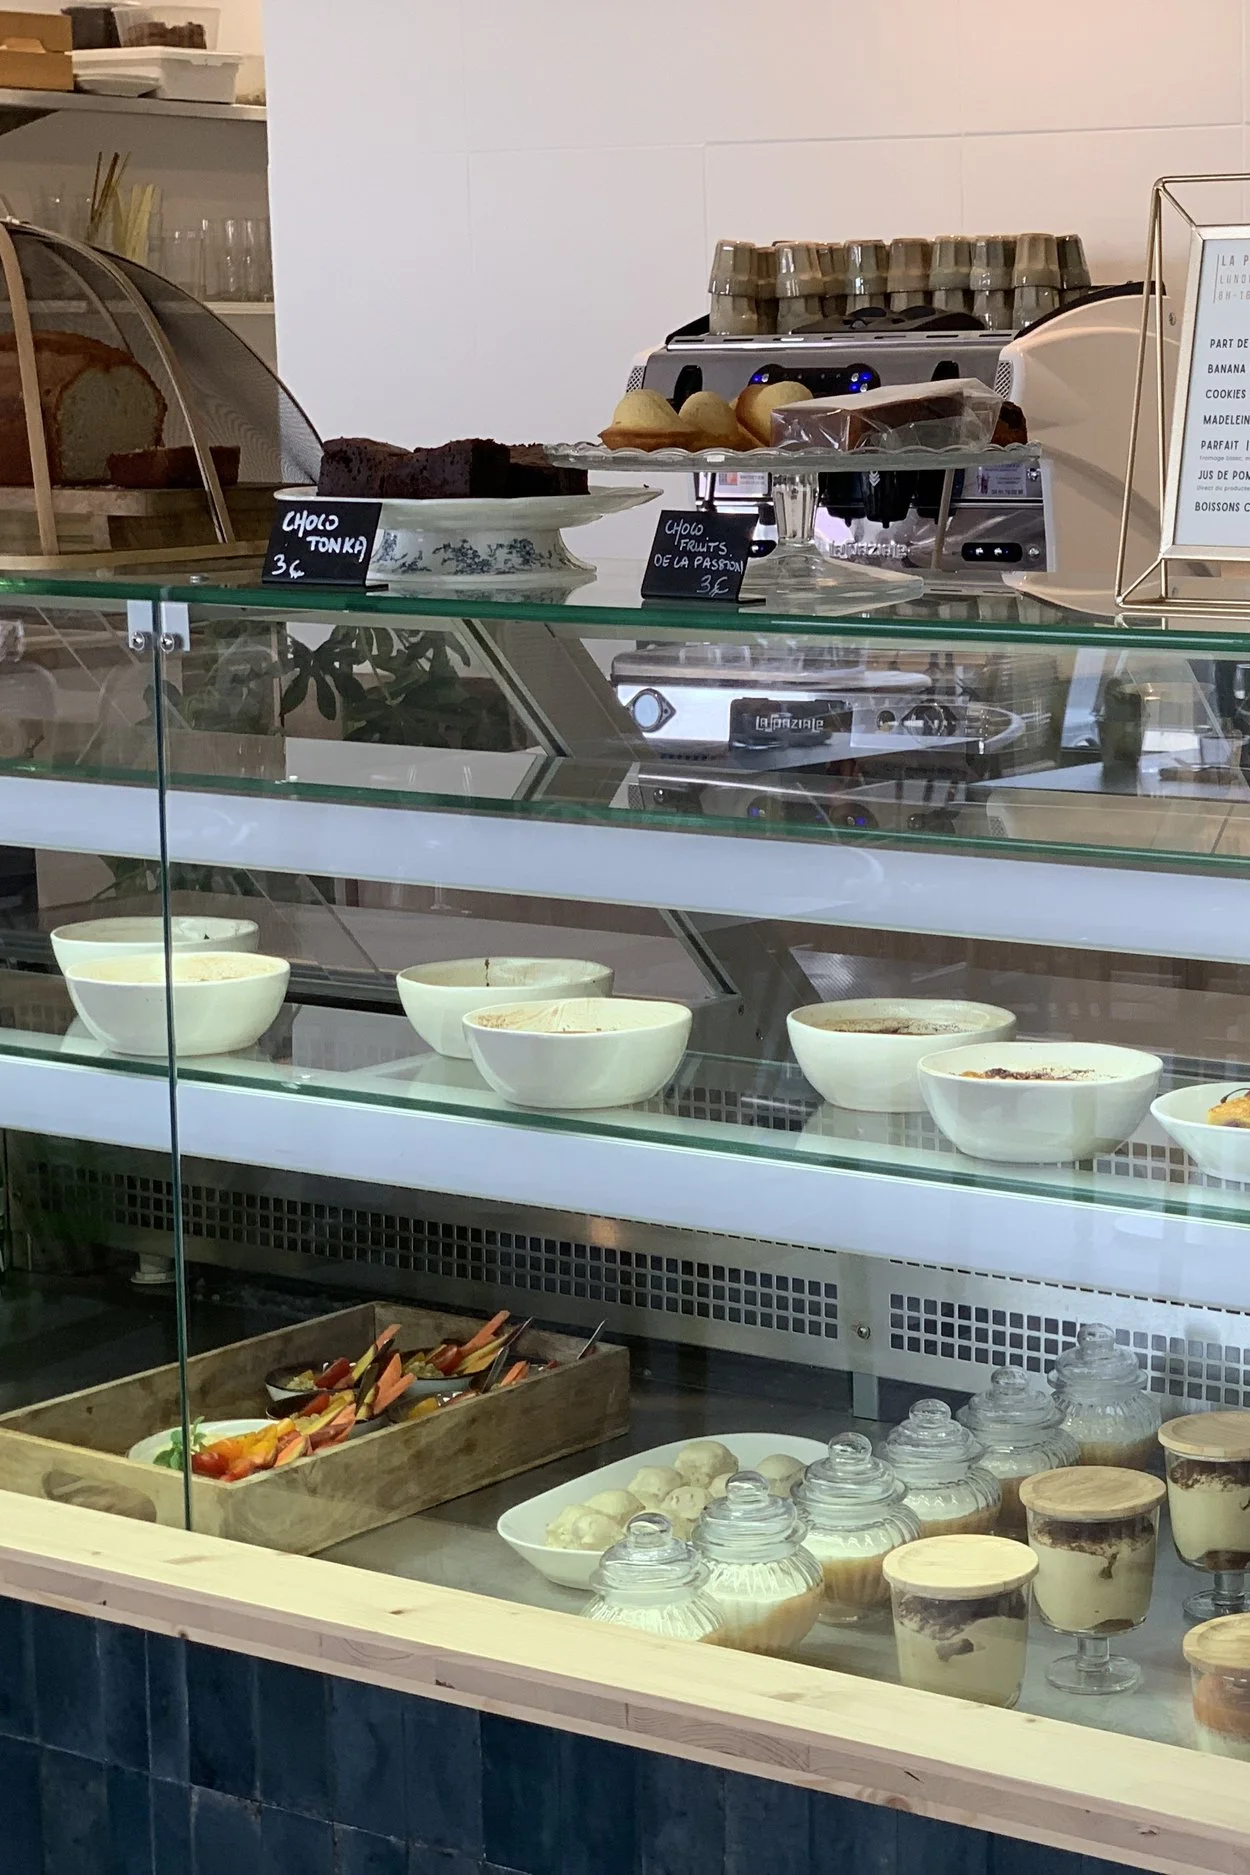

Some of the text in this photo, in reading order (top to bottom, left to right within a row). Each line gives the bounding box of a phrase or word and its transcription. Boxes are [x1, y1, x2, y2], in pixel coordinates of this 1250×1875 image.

[1221, 255, 1236, 266] LA
[1219, 273, 1250, 285] LUNDI
[1210, 338, 1233, 349] PART
[1237, 338, 1248, 349] DE
[1207, 364, 1246, 374] BANANA
[1205, 389, 1246, 399] COOKIES
[1201, 440, 1239, 451] PARFAIT
[1198, 470, 1213, 480] JUS
[1217, 470, 1229, 480] DE
[1195, 501, 1240, 512] BOISSONS
[282, 510, 339, 537] CHOCO
[665, 519, 704, 545] CHOCO
[306, 536, 367, 563] TONKA
[679, 537, 728, 556] FRUITS
[654, 554, 672, 566] DE
[674, 557, 688, 568] LA
[697, 575, 729, 596] 3€
